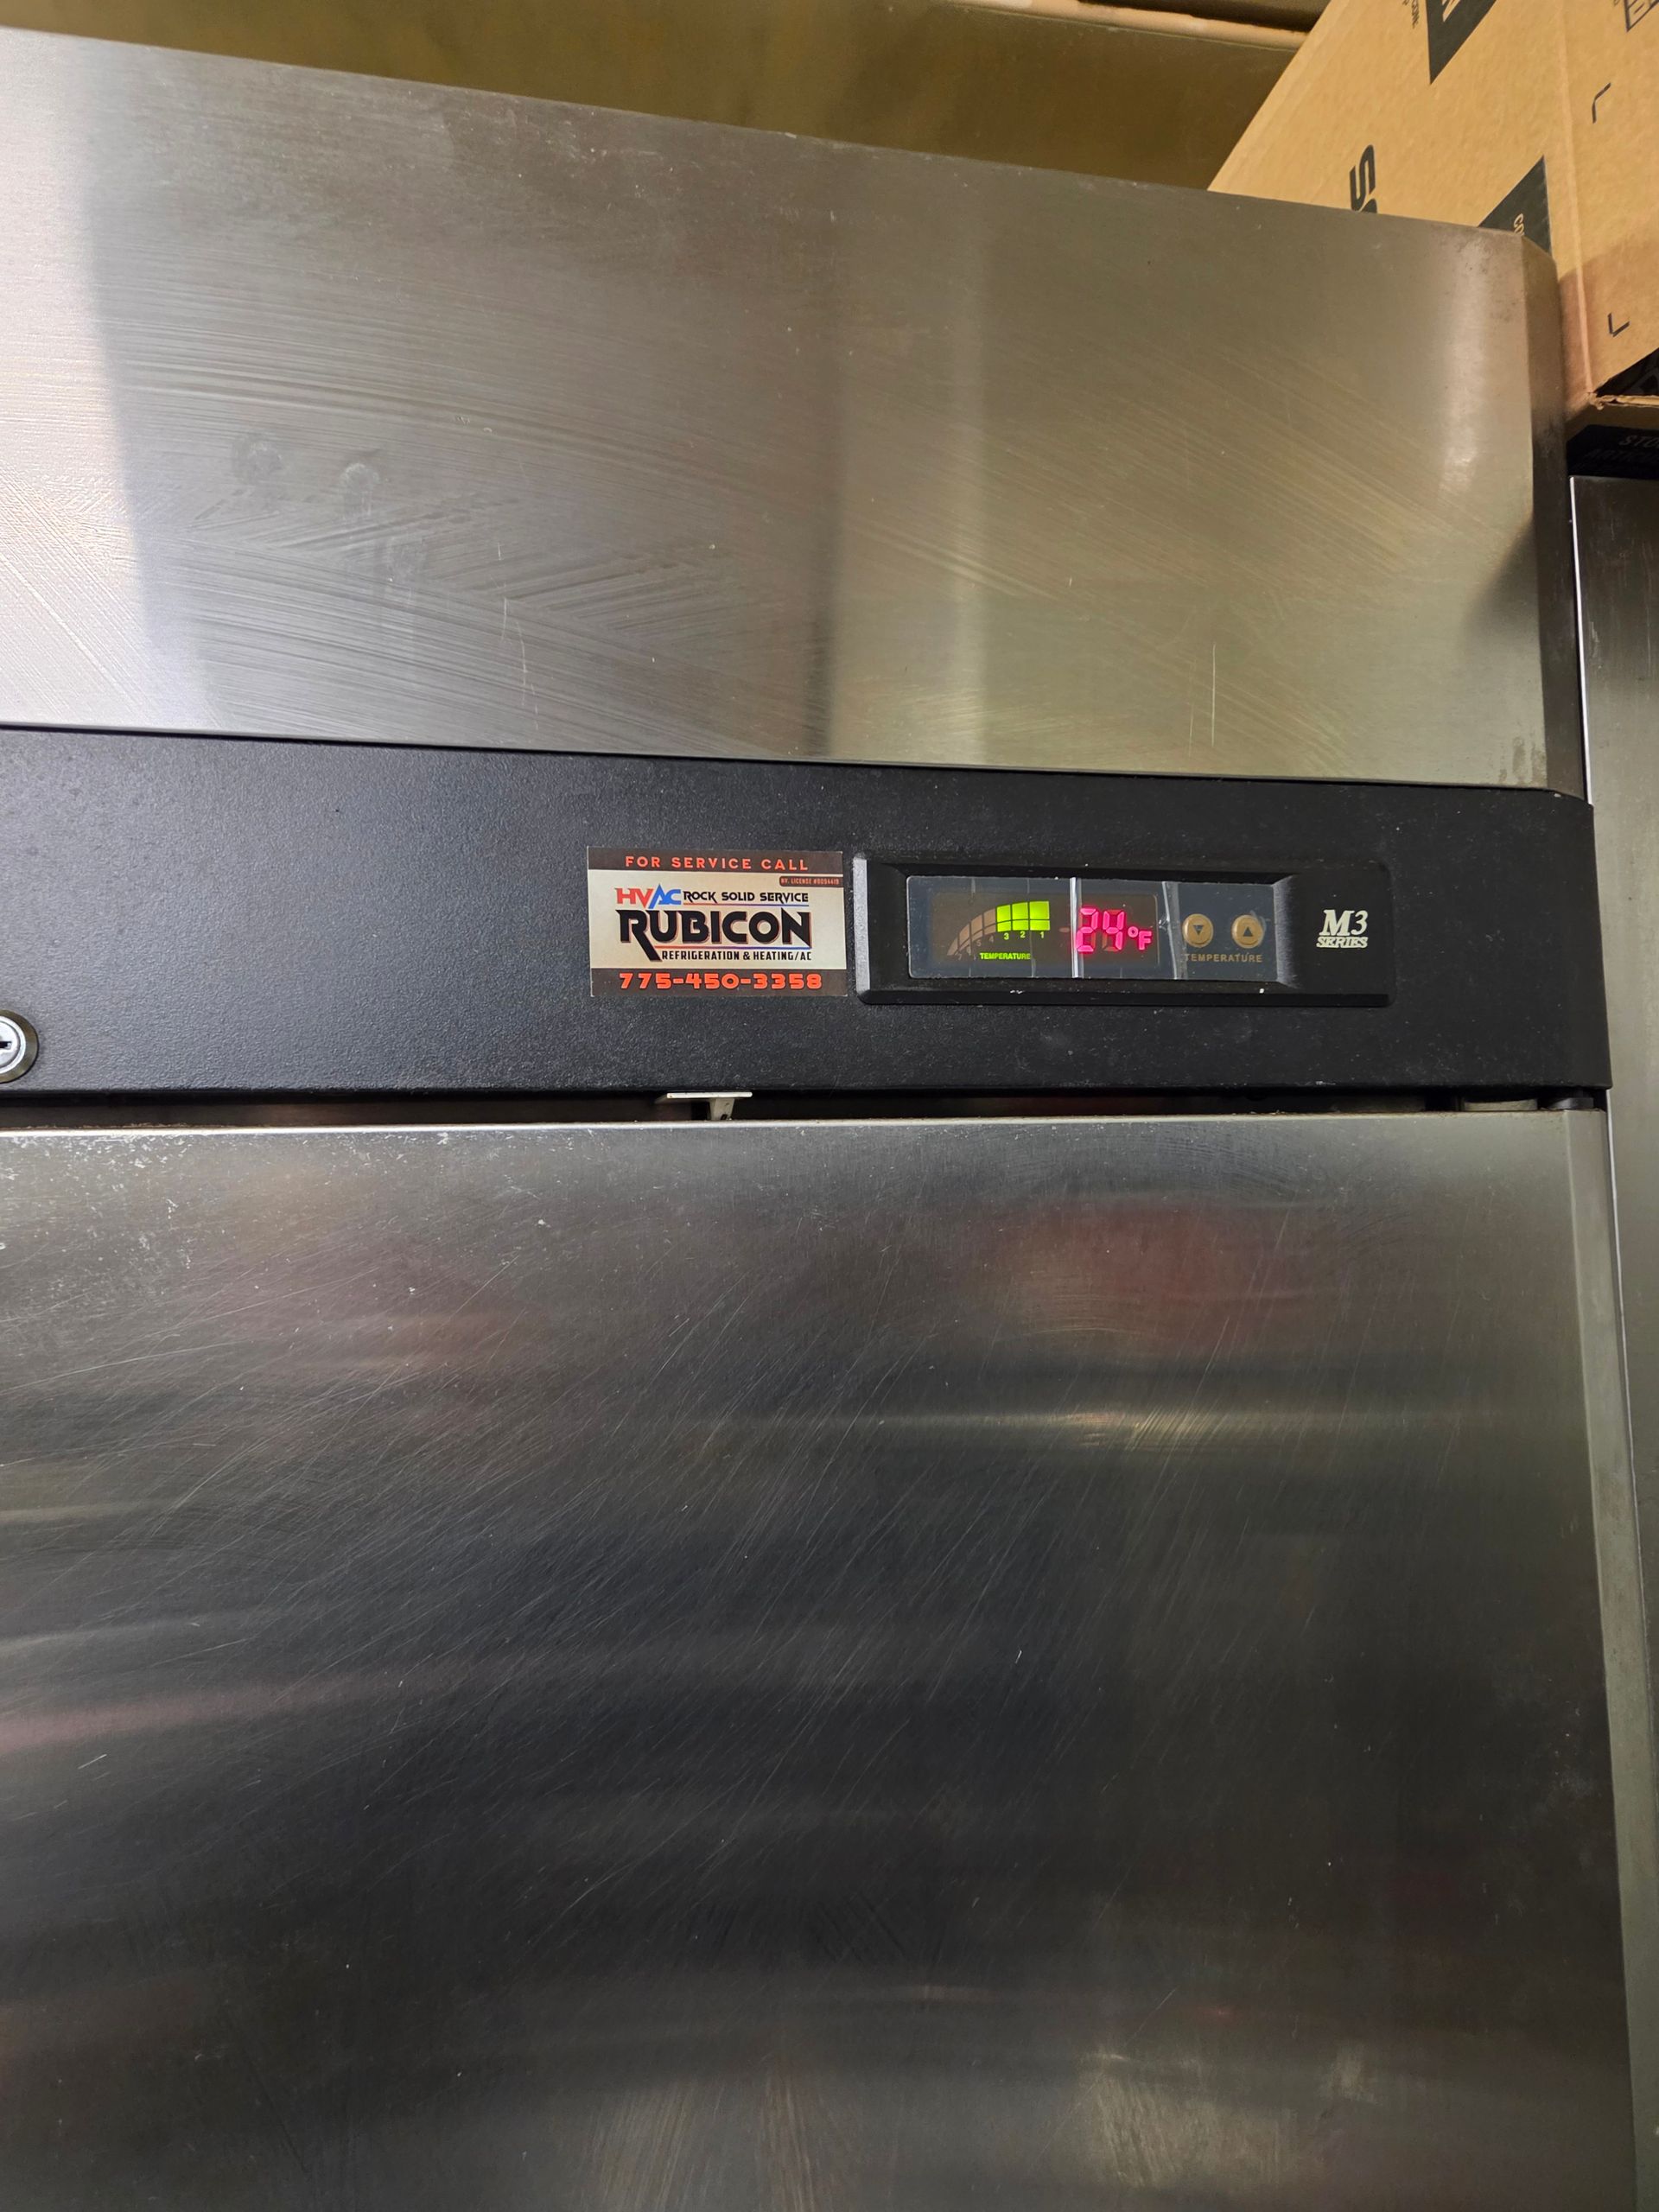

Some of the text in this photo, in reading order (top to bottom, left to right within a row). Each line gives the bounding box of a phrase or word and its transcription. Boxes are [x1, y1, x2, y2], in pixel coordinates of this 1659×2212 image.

[625, 855, 809, 871] FOR SERVICE CALL
[614, 883, 809, 910] HVAC ROCK SOLID SERVICE
[1319, 909, 1369, 936] M3
[615, 906, 812, 962] RUBICON
[1316, 936, 1369, 949] SERIES
[662, 950, 812, 961] REFRIGERATION & HEATING/AC
[979, 951, 1032, 961] TEMPERATURE
[1185, 952, 1262, 963] TEMPERATURE
[619, 972, 823, 990] 775-450-3358
